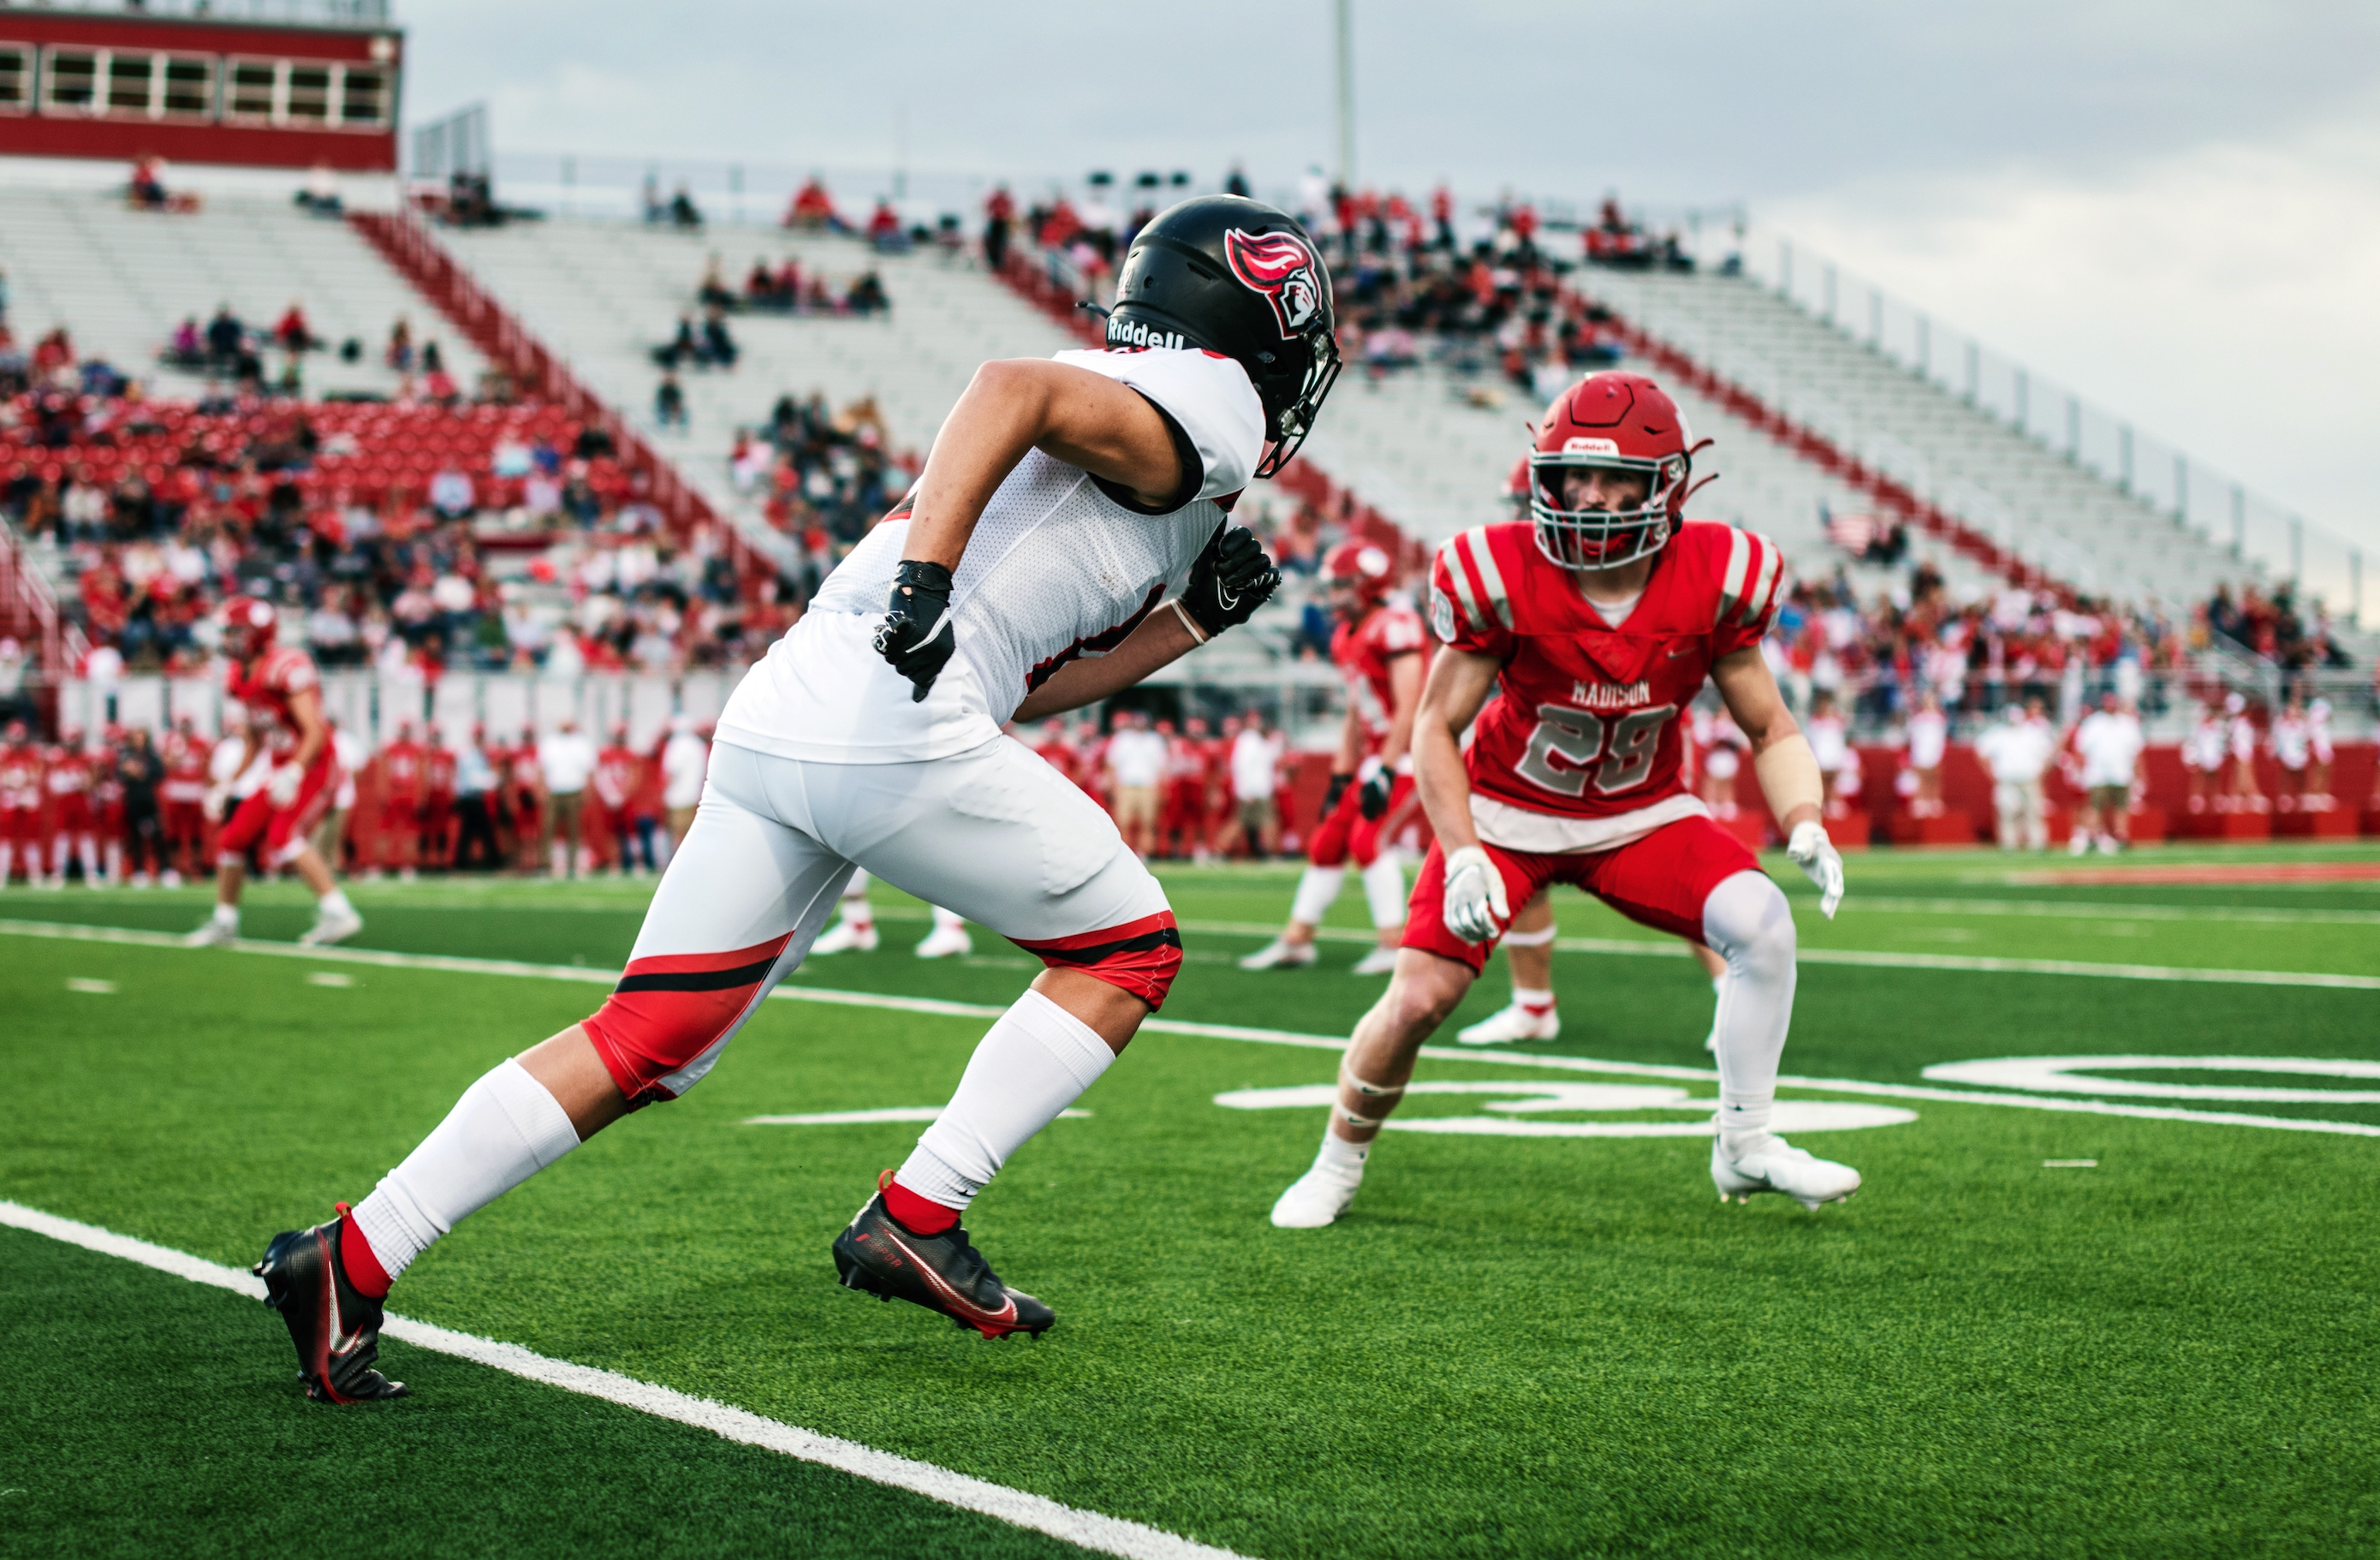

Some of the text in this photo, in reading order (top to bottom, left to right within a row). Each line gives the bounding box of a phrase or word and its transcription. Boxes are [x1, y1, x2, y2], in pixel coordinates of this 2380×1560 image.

[1108, 318, 1184, 350] Riddell
[1571, 443, 1610, 451] Riddell
[1572, 680, 1650, 707] MADISON
